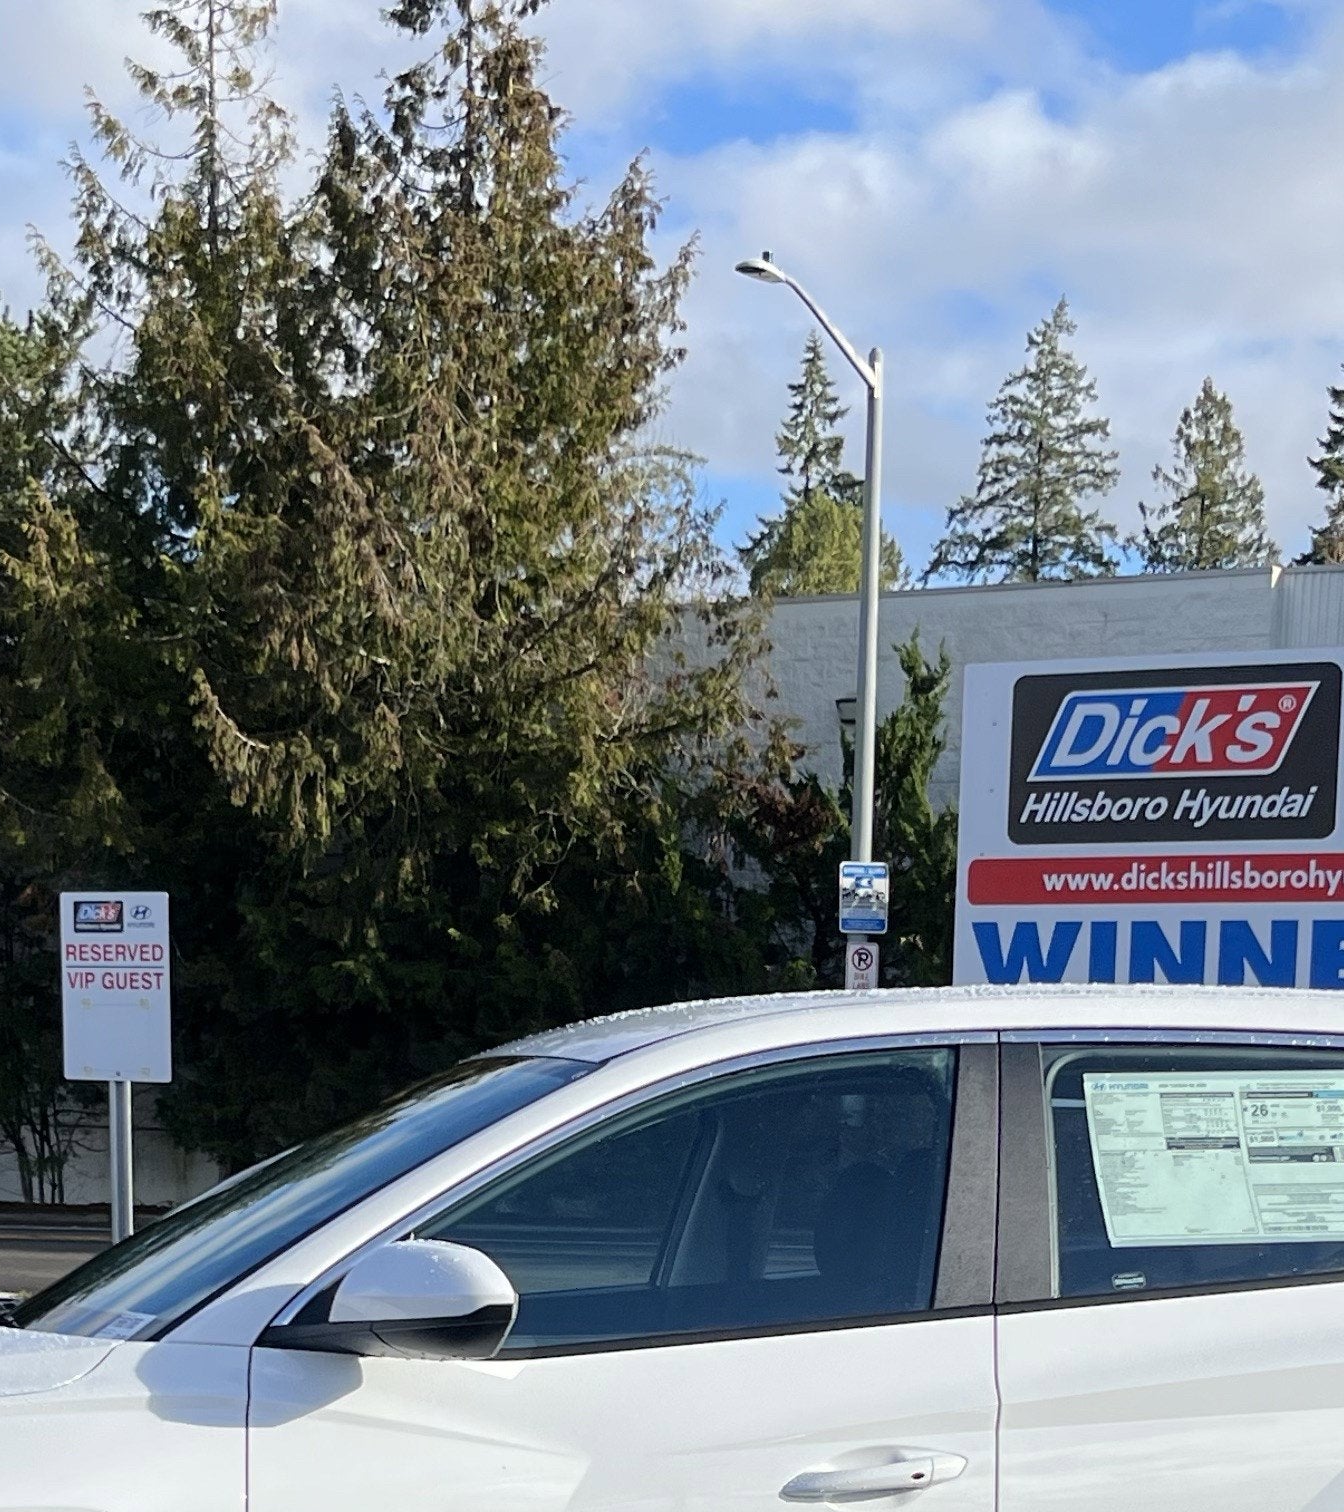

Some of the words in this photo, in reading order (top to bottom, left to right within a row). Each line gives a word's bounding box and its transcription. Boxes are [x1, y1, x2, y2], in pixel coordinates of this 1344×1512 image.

[1050, 695, 1281, 767] Dick's
[1020, 791, 1168, 823] Hillsboro
[1173, 786, 1318, 827] Hyundai
[65, 944, 164, 962] RESERVED
[67, 972, 95, 989] VIP
[102, 972, 164, 990] GUEST
[1251, 1104, 1268, 1117] 26
